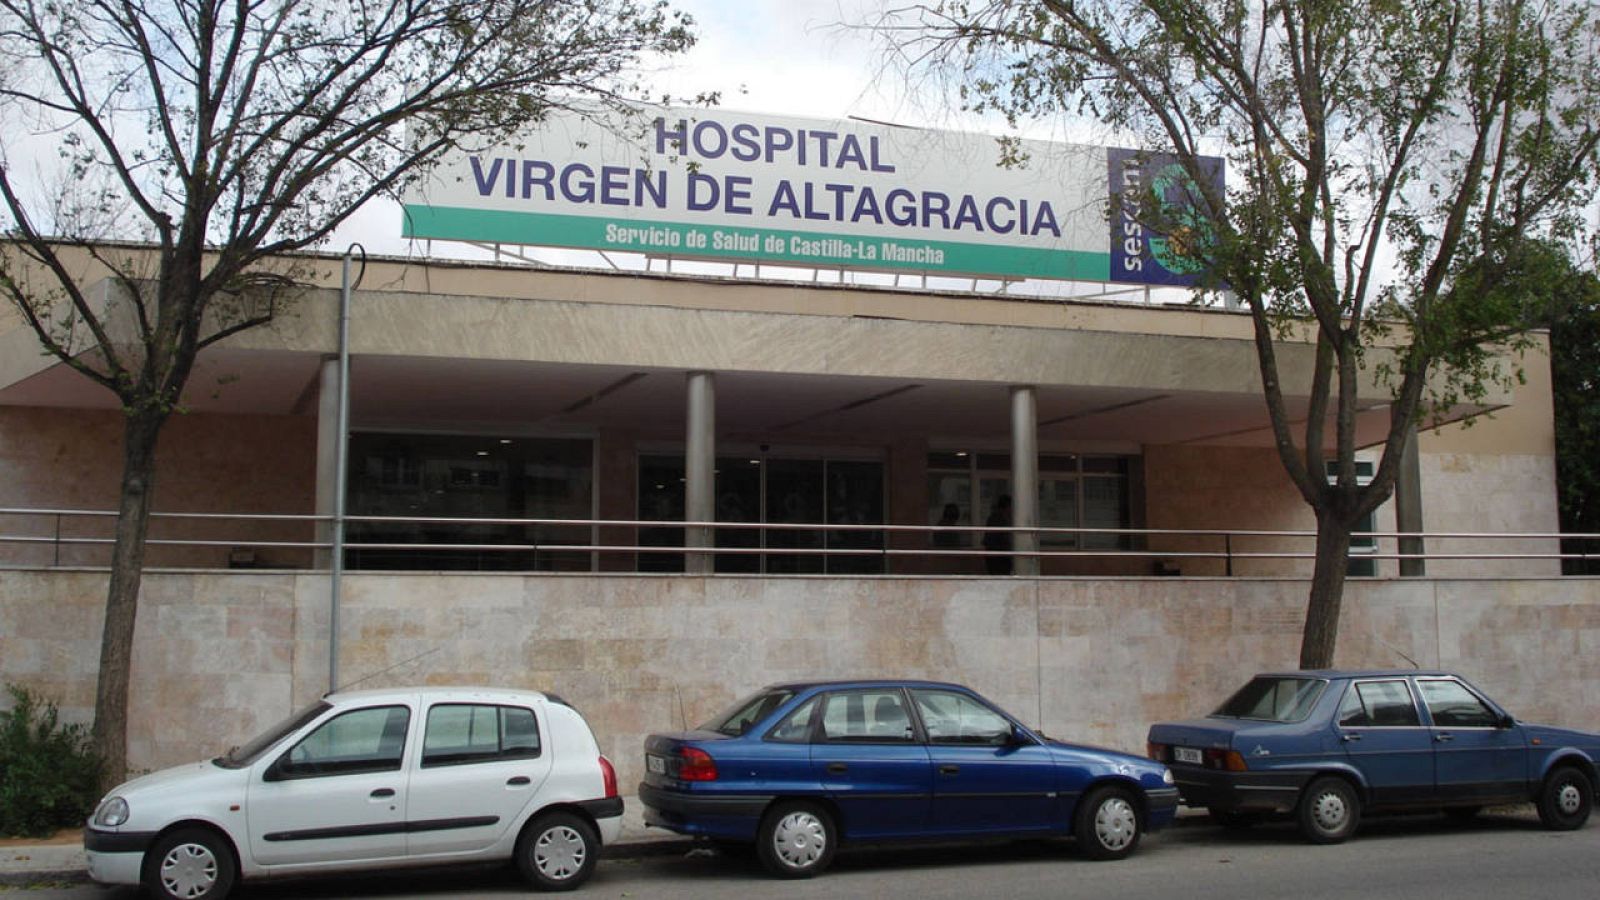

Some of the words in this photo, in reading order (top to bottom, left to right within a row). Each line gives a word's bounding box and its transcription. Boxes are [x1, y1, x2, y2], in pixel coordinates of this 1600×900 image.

[656, 117, 895, 173] HOSPITAL
[470, 157, 667, 208] VIRGEN
[688, 174, 753, 214] DE
[768, 179, 1061, 237] ALTAGRACIA
[606, 225, 681, 249] Servicio
[686, 230, 706, 250] de
[713, 232, 759, 253] Salud
[765, 235, 785, 255] de
[790, 236, 877, 261] Castilla-La
[882, 244, 945, 265] Mancha
